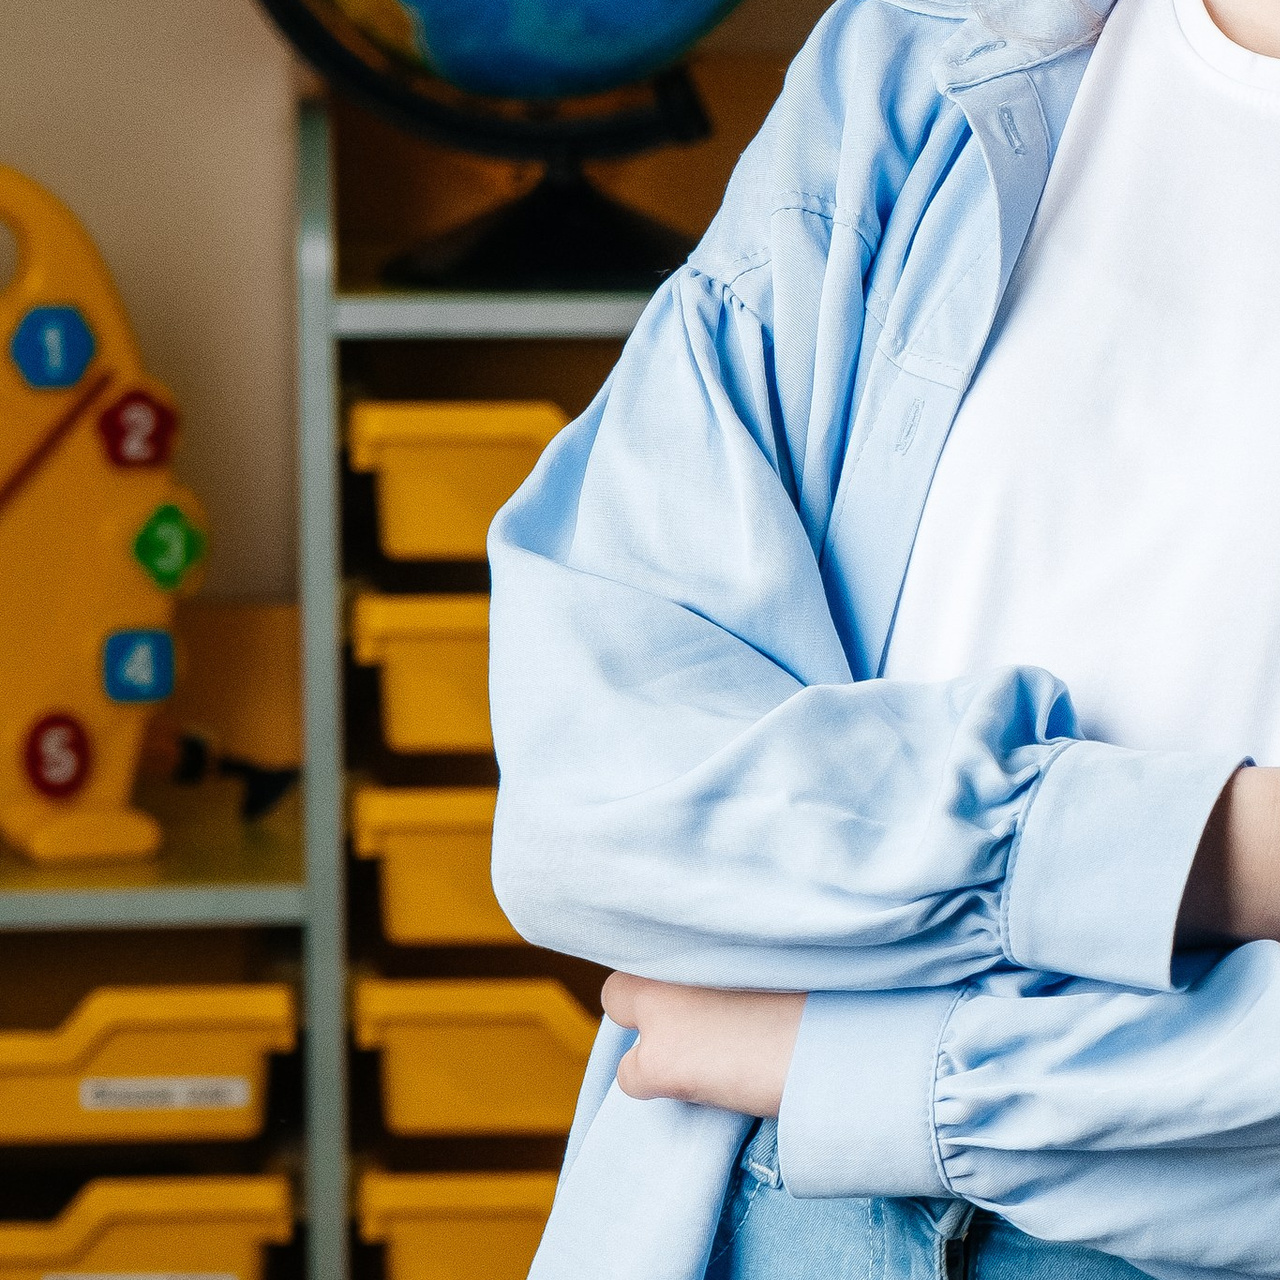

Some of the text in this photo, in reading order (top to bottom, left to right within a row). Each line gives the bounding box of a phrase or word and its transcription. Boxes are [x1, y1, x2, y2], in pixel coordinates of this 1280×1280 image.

[41, 327, 66, 371] 1
[120, 399, 154, 460] 2
[154, 522, 187, 571] 3
[123, 644, 154, 686] 4
[41, 731, 75, 784] 5
